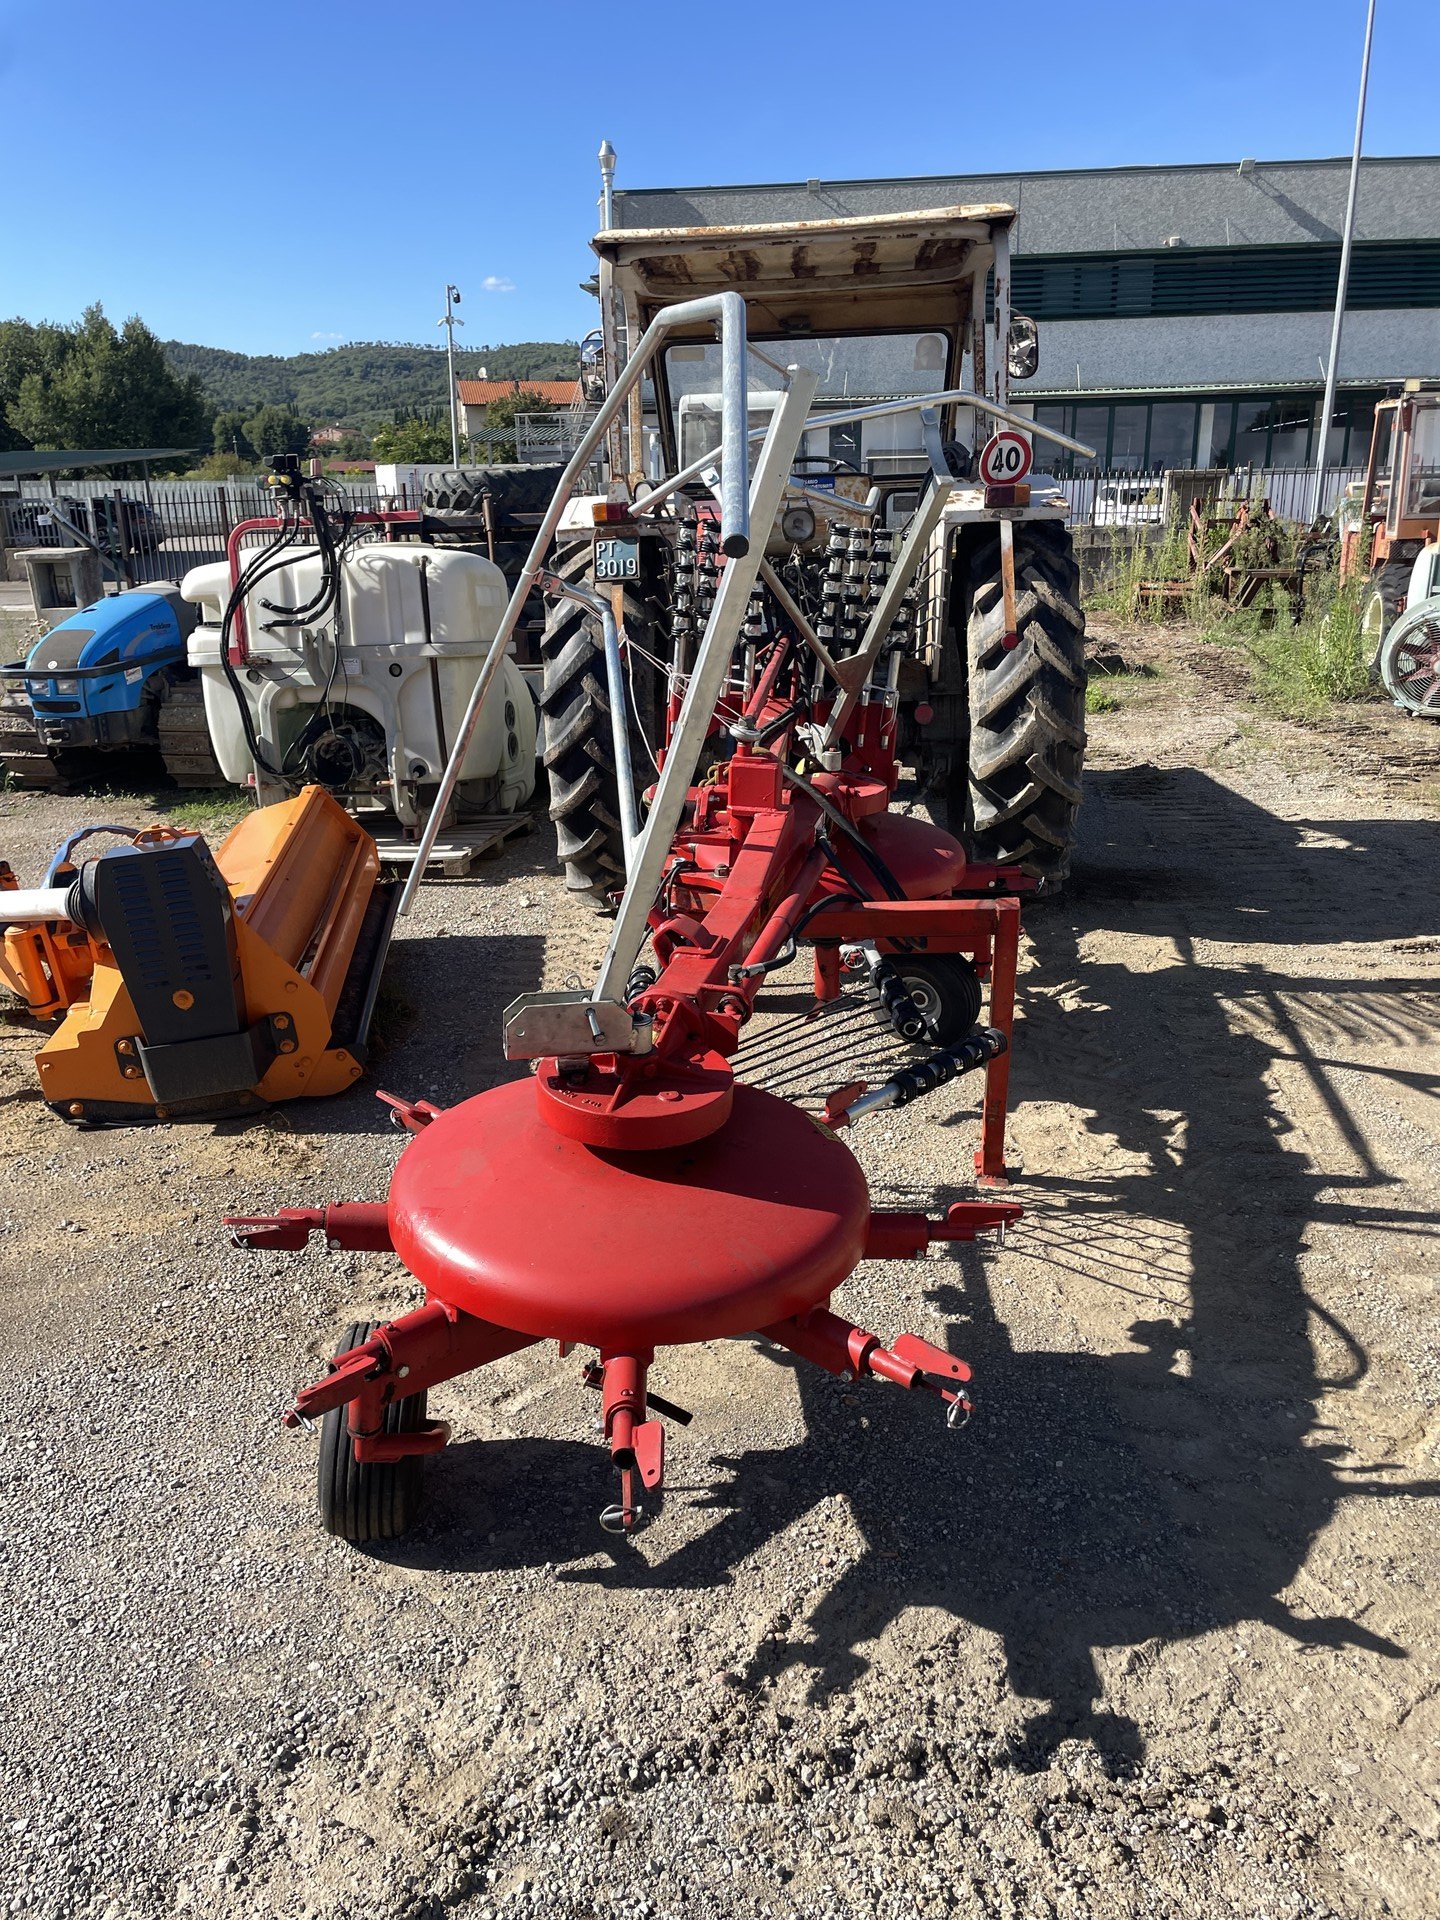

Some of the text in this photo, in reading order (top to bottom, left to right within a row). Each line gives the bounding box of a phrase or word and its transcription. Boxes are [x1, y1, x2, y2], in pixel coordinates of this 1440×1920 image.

[992, 446, 1020, 472] 40
[596, 541, 616, 559] PT
[596, 558, 636, 577] 3019
